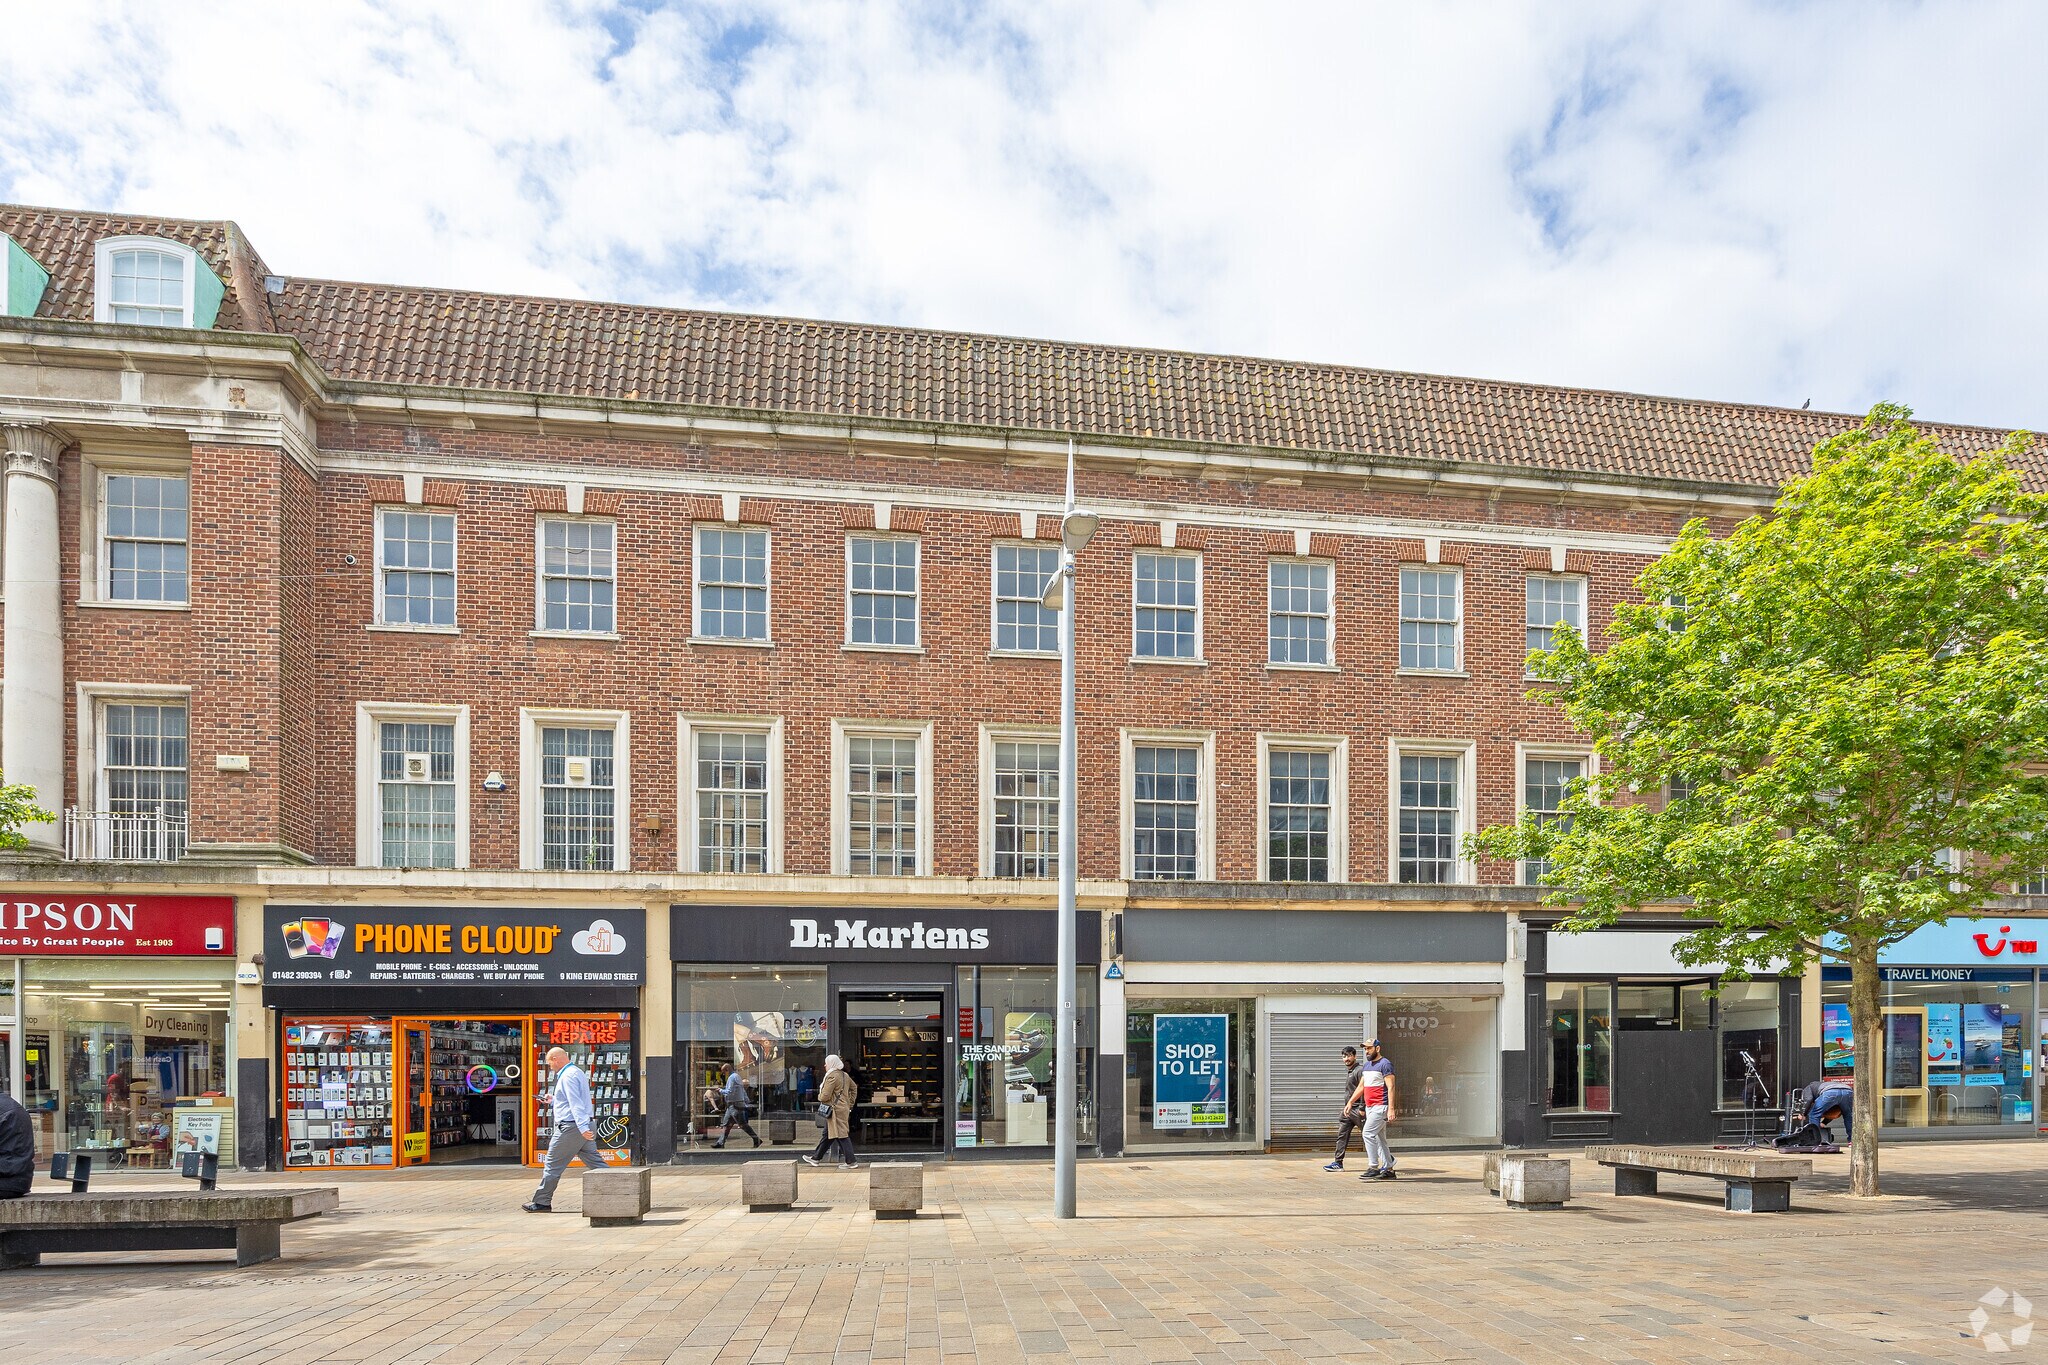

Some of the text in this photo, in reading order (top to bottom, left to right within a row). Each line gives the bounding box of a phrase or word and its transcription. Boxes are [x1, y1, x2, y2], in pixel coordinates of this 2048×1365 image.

[22, 937, 38, 948] By
[43, 937, 78, 946] Great
[82, 937, 125, 948] People
[136, 938, 152, 946] Est
[153, 938, 174, 946] 1903
[355, 923, 452, 953] PHONE
[2009, 940, 2038, 954] TUI
[272, 971, 322, 980] 01482 390394
[613, 972, 638, 980] STREET
[1885, 968, 1972, 980] TRAVEL MONEY
[146, 1016, 208, 1035] Dry Cleaning
[550, 1032, 617, 1044] REPAIRS
[984, 1045, 1030, 1053] SANDALS
[1165, 1044, 1216, 1059] SHOP
[1158, 1060, 1222, 1075] TO LET
